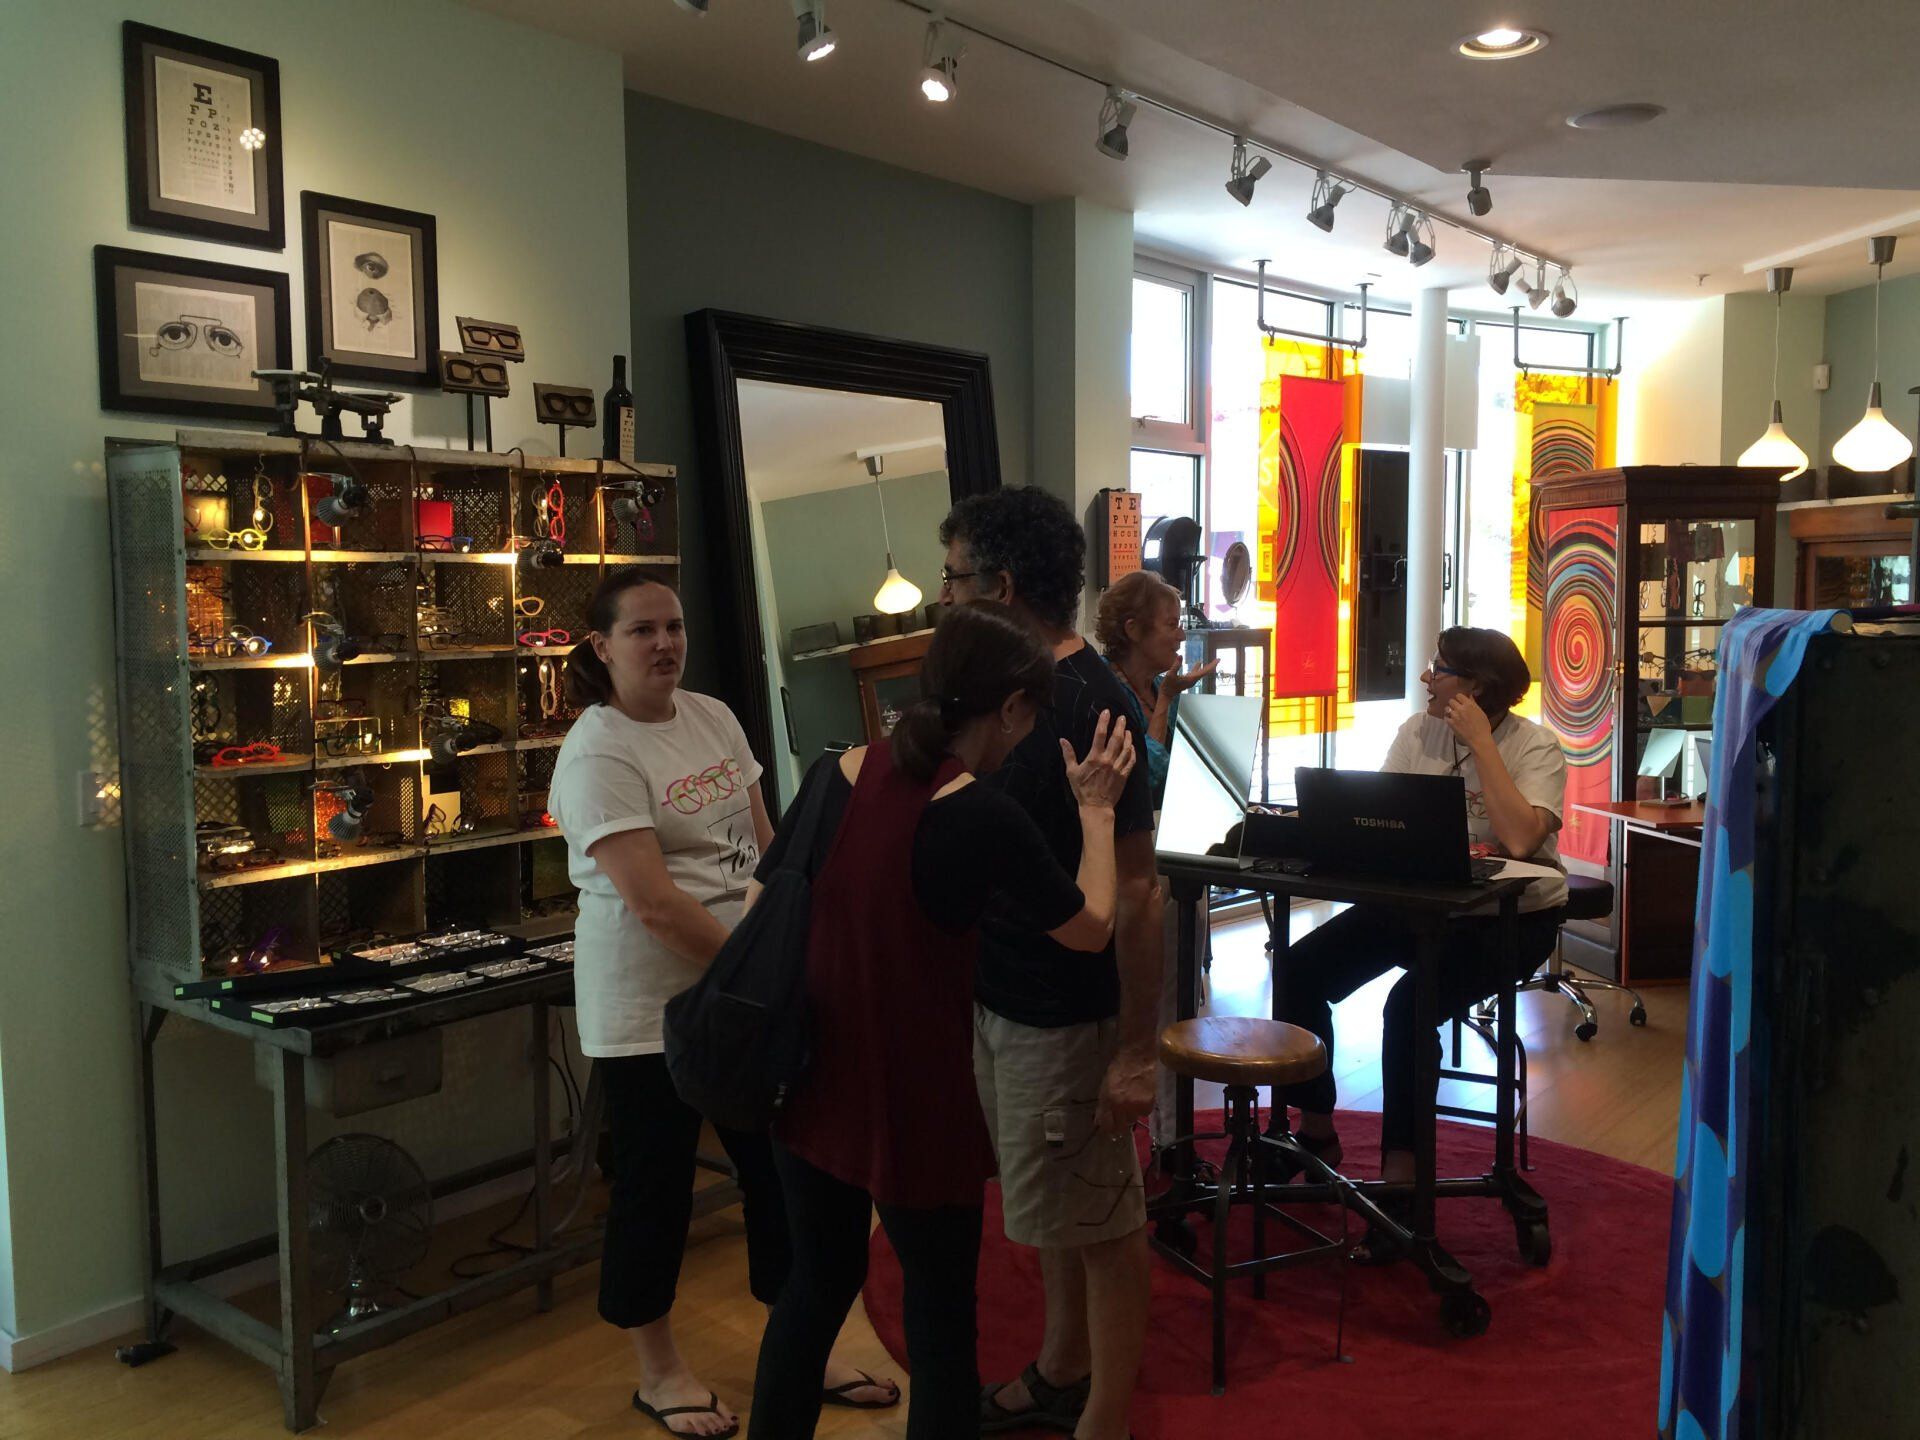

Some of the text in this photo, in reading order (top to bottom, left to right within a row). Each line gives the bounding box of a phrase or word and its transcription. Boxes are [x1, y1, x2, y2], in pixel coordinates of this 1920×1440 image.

[193, 83, 212, 105] E
[627, 408, 633, 418] E
[1115, 497, 1136, 510] T E
[1354, 817, 1405, 829] TOSHIBA
